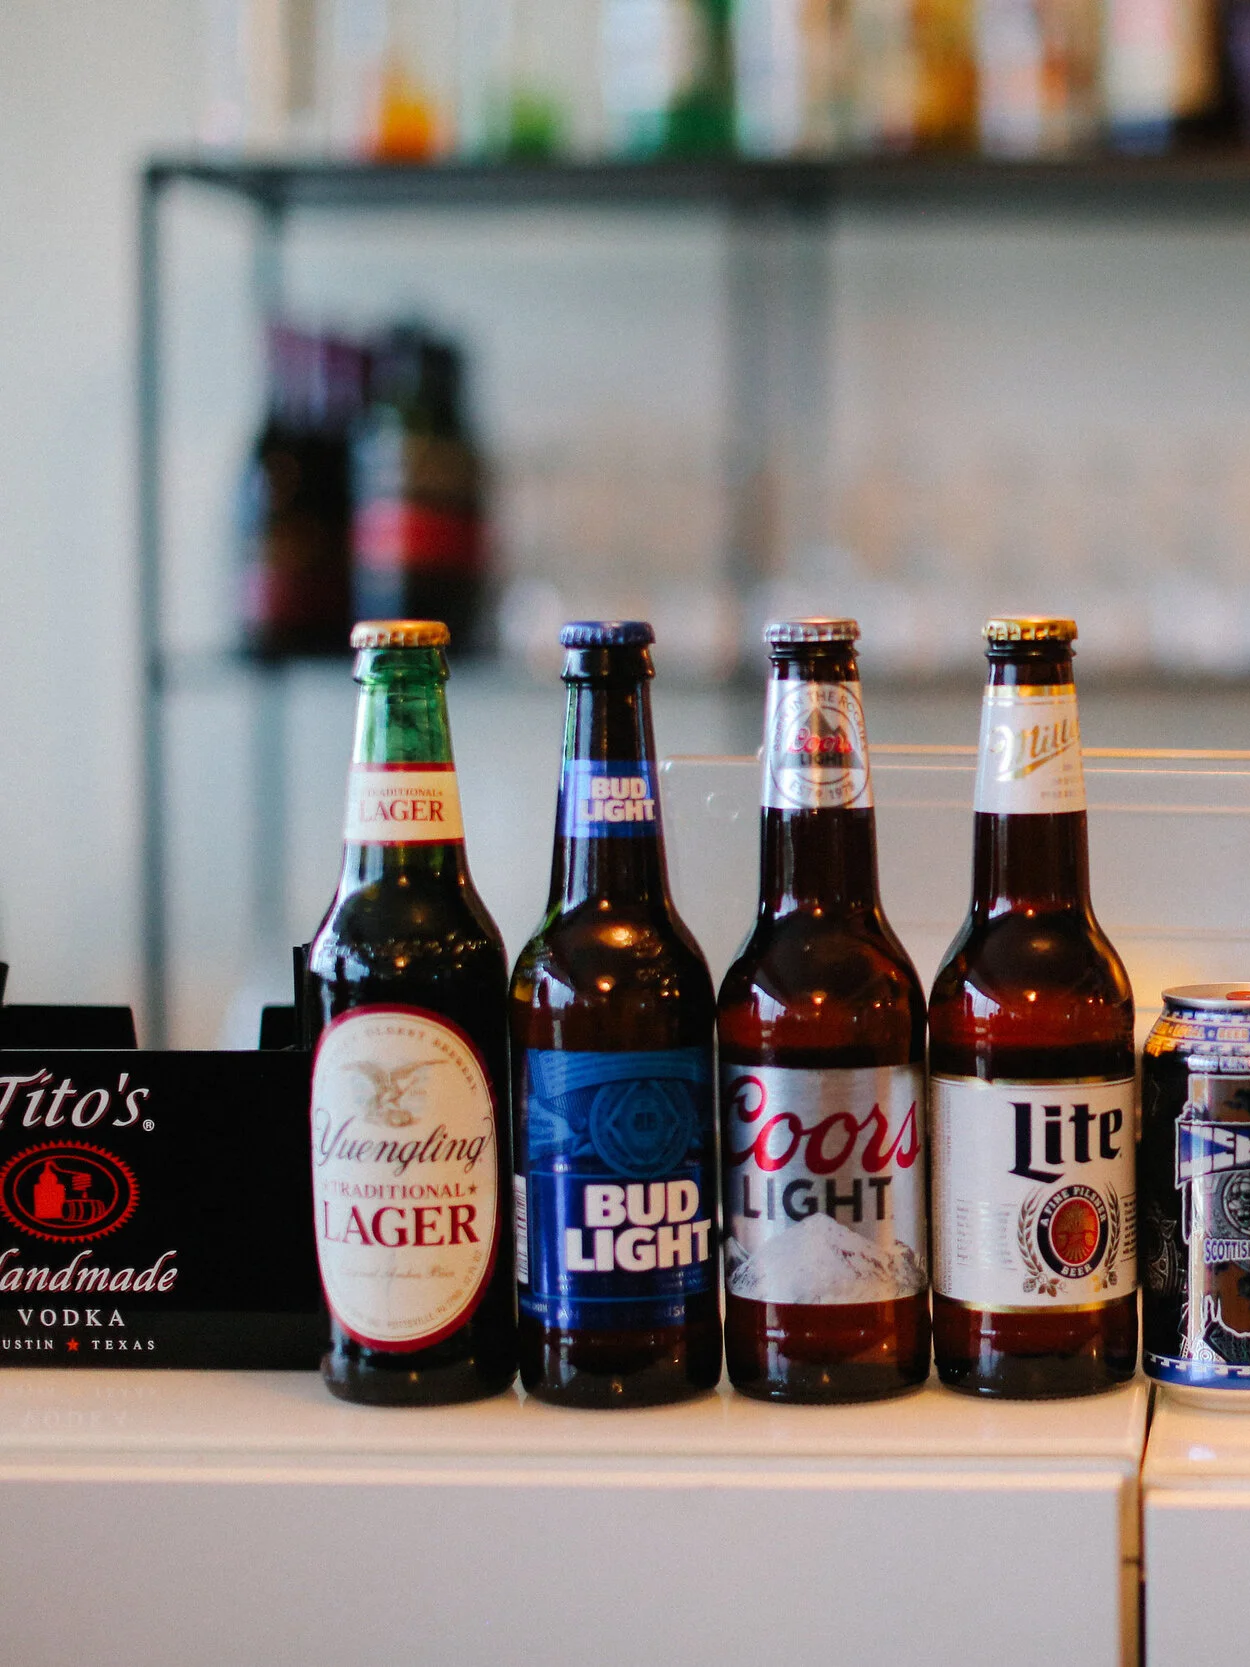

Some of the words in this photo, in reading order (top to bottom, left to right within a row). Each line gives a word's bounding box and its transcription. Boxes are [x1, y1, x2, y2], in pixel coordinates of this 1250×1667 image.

[788, 728, 853, 755] Coors
[799, 752, 844, 766] LIGHT
[590, 777, 648, 800] BUD
[359, 799, 445, 822] LAGER
[581, 799, 657, 823] LIGHT
[726, 1074, 921, 1175] Coors
[313, 1107, 495, 1177] Yuengling
[1008, 1101, 1123, 1184] Lite
[331, 1181, 466, 1200] TRADITIONAL
[583, 1179, 700, 1228] BUD
[742, 1174, 893, 1223] LIGHT
[1043, 1188, 1070, 1214] FINE
[1072, 1185, 1108, 1223] PILSNER
[322, 1199, 480, 1248] LAGER
[564, 1219, 712, 1273] LIGHT
[1060, 1263, 1093, 1278] BEER
[17, 1309, 125, 1328] VODKA
[0, 1340, 54, 1350] USTIN
[92, 1340, 155, 1350] TEXAS
